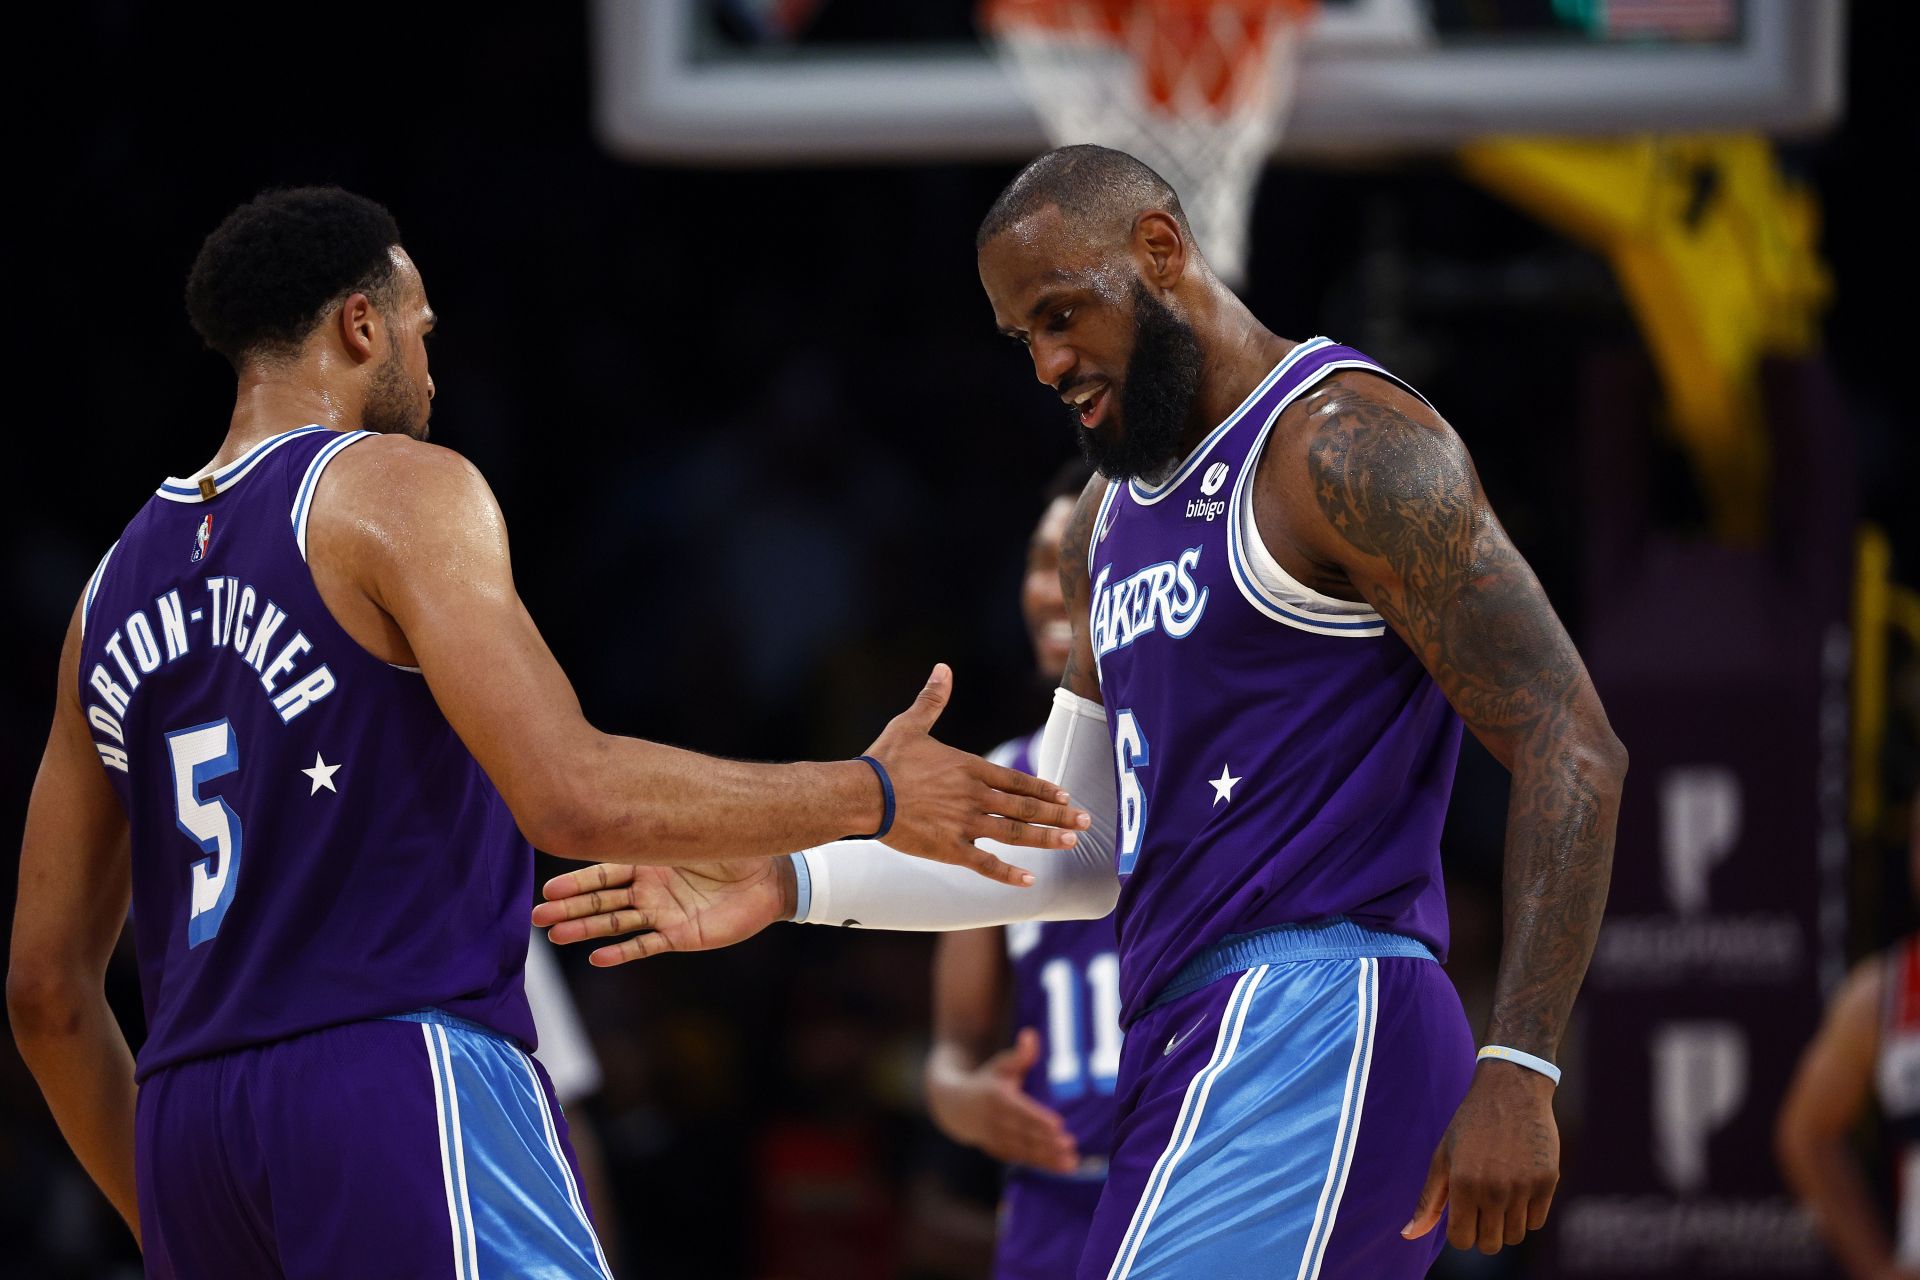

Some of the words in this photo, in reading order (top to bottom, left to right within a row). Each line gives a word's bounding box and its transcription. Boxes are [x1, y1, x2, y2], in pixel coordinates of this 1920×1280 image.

[1186, 498, 1225, 521] bibigo
[87, 576, 336, 773] HORTON-TUCKER
[164, 717, 242, 949] 5
[1115, 707, 1149, 875] 6
[1041, 952, 1122, 1100] 11
